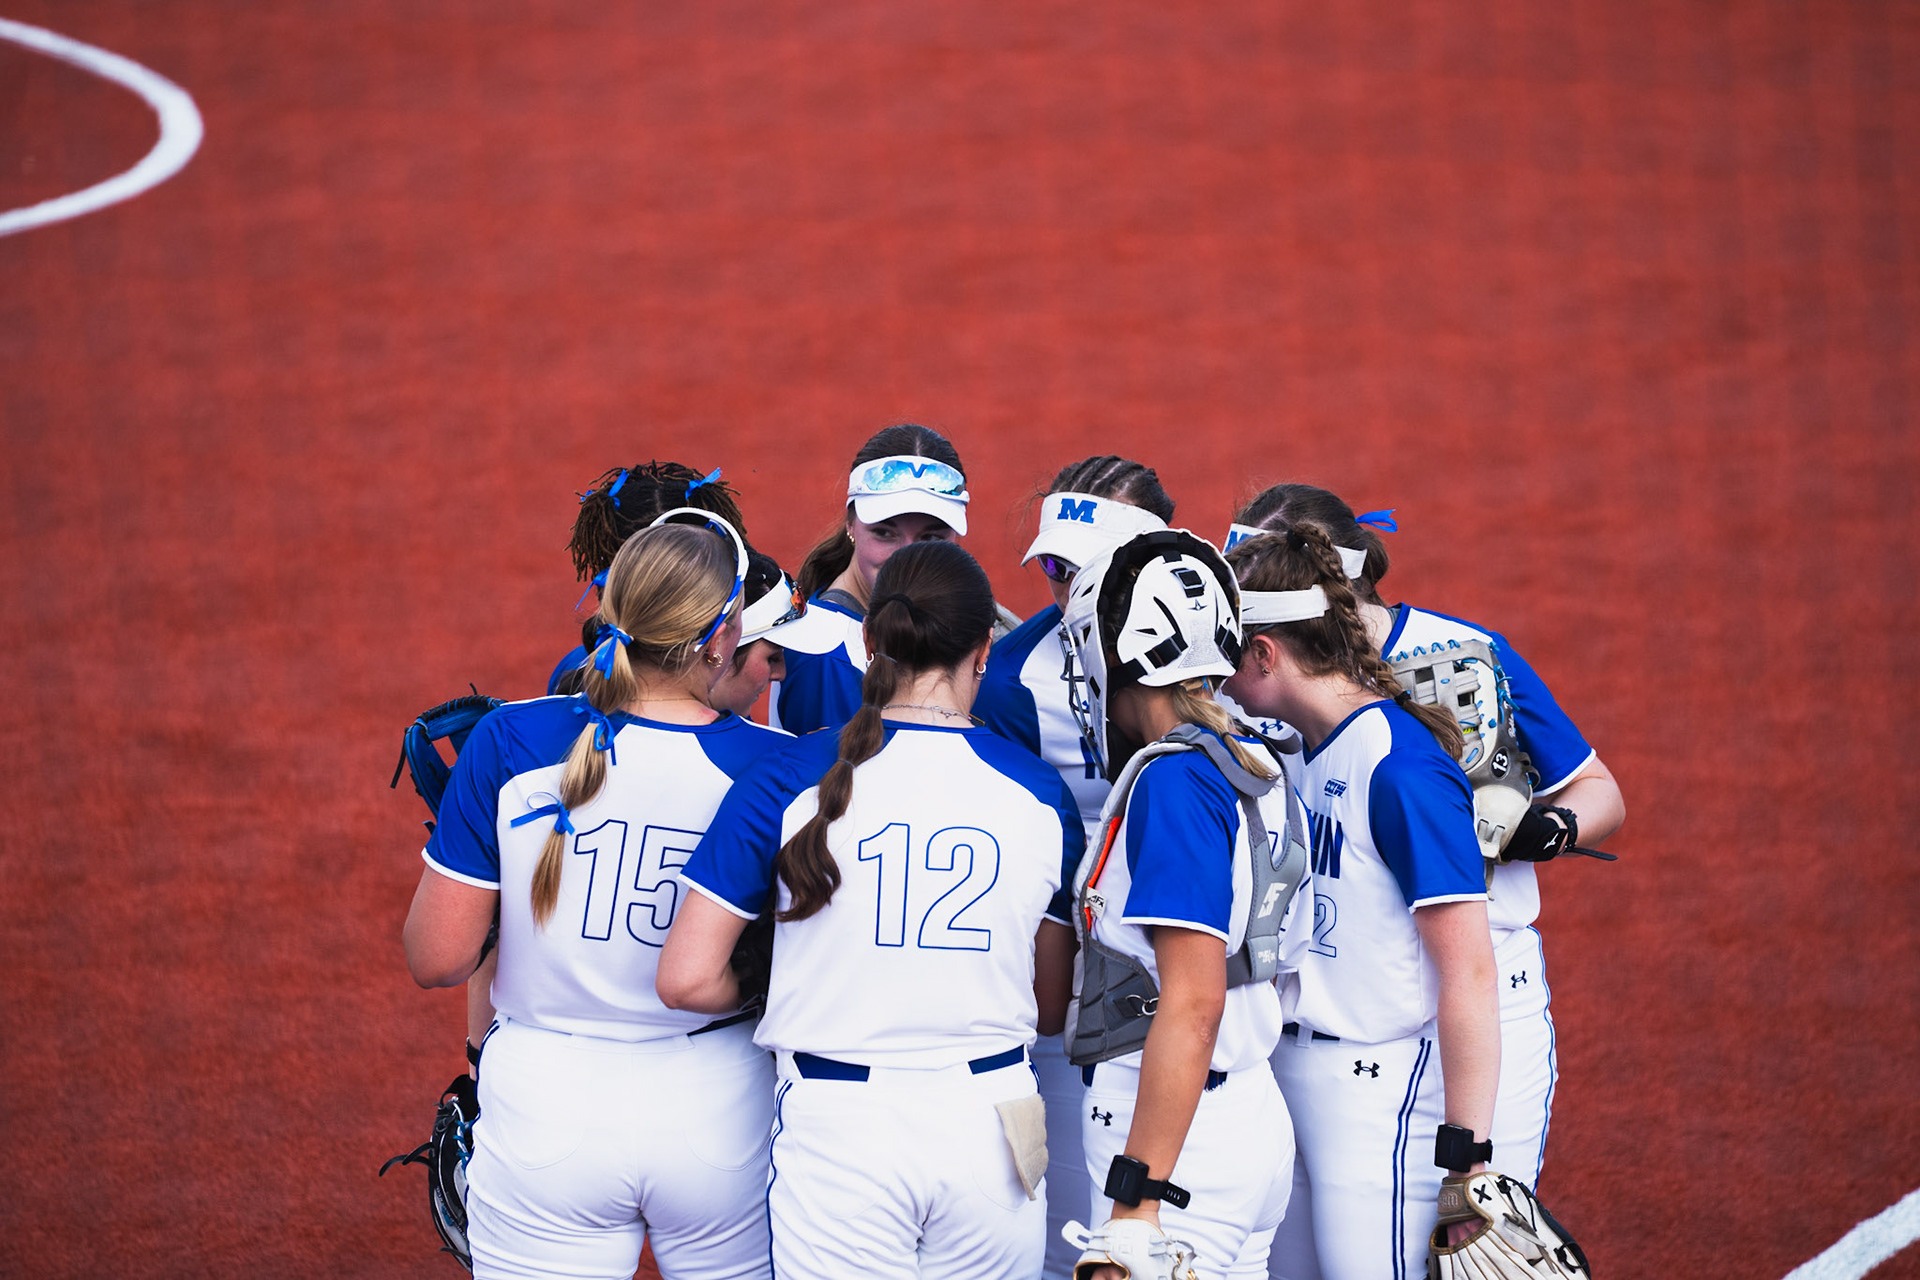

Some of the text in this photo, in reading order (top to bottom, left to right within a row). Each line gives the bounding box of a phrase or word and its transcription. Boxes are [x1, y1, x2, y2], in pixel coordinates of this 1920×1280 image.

[1057, 498, 1097, 524] M
[1492, 752, 1508, 772] 13
[574, 818, 706, 948] 15
[858, 822, 1001, 952] 12
